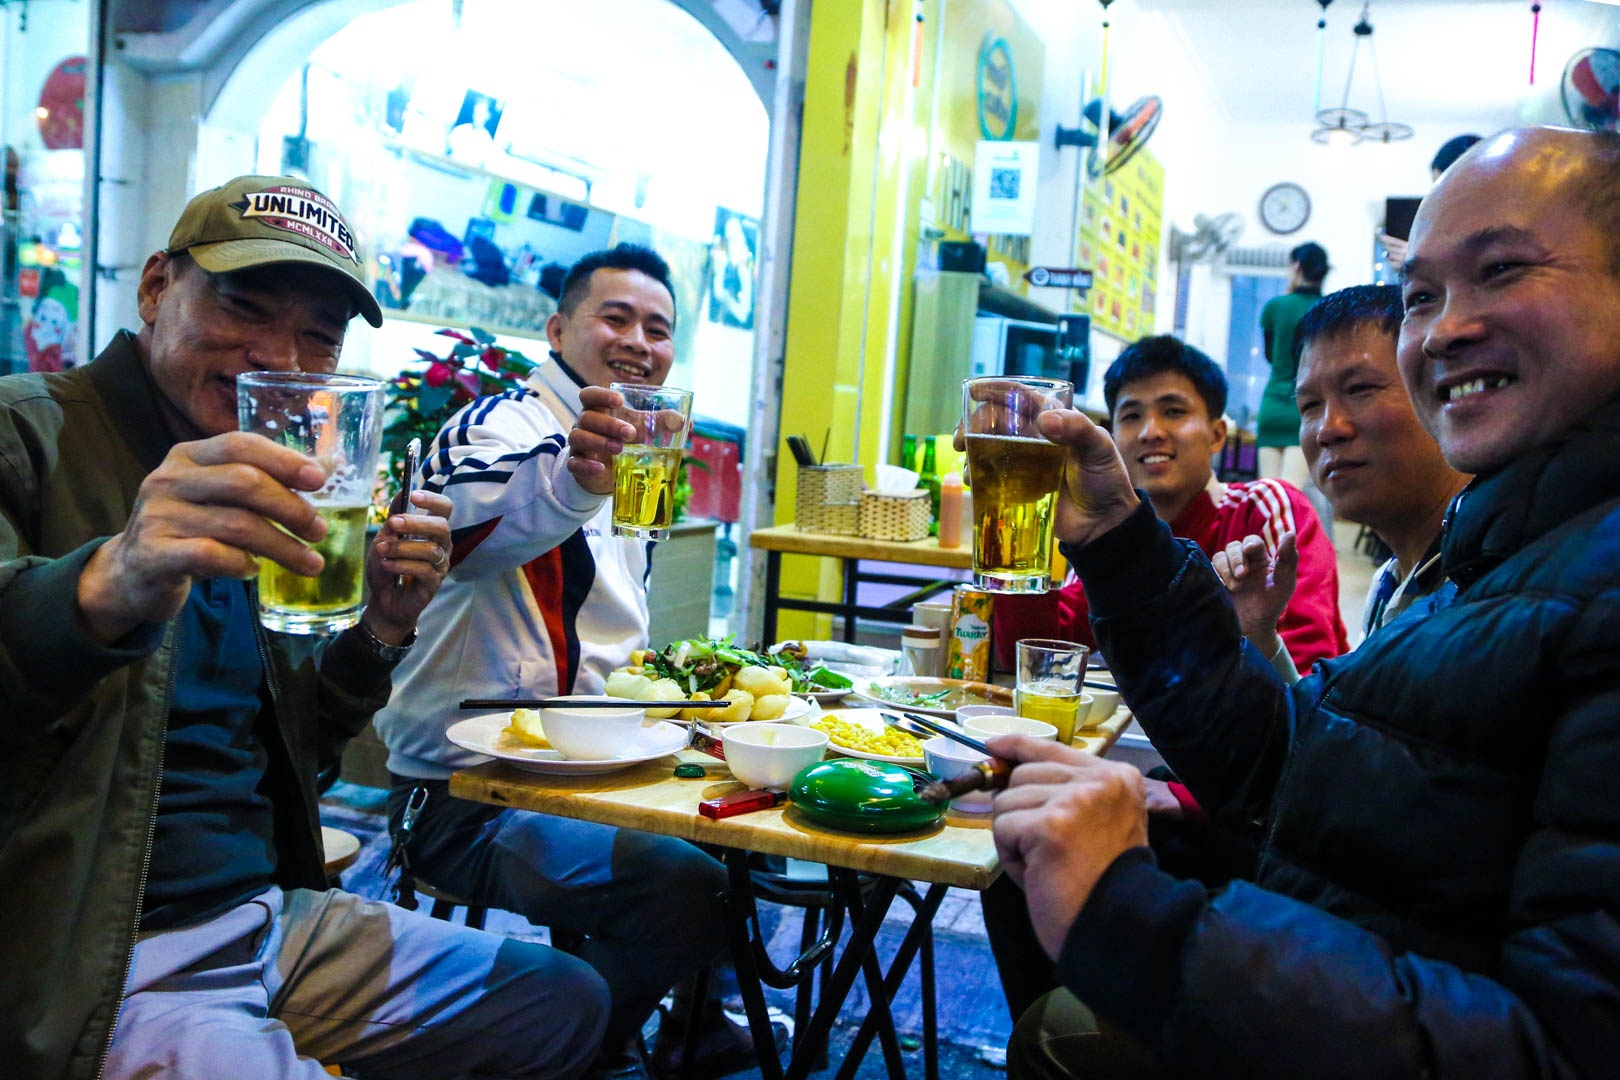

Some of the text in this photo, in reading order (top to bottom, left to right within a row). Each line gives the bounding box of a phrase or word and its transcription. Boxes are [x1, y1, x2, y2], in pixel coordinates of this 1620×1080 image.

[280, 186, 311, 197] RHINO
[254, 195, 354, 252] UNLIMITED
[286, 220, 333, 247] MCMLXXII
